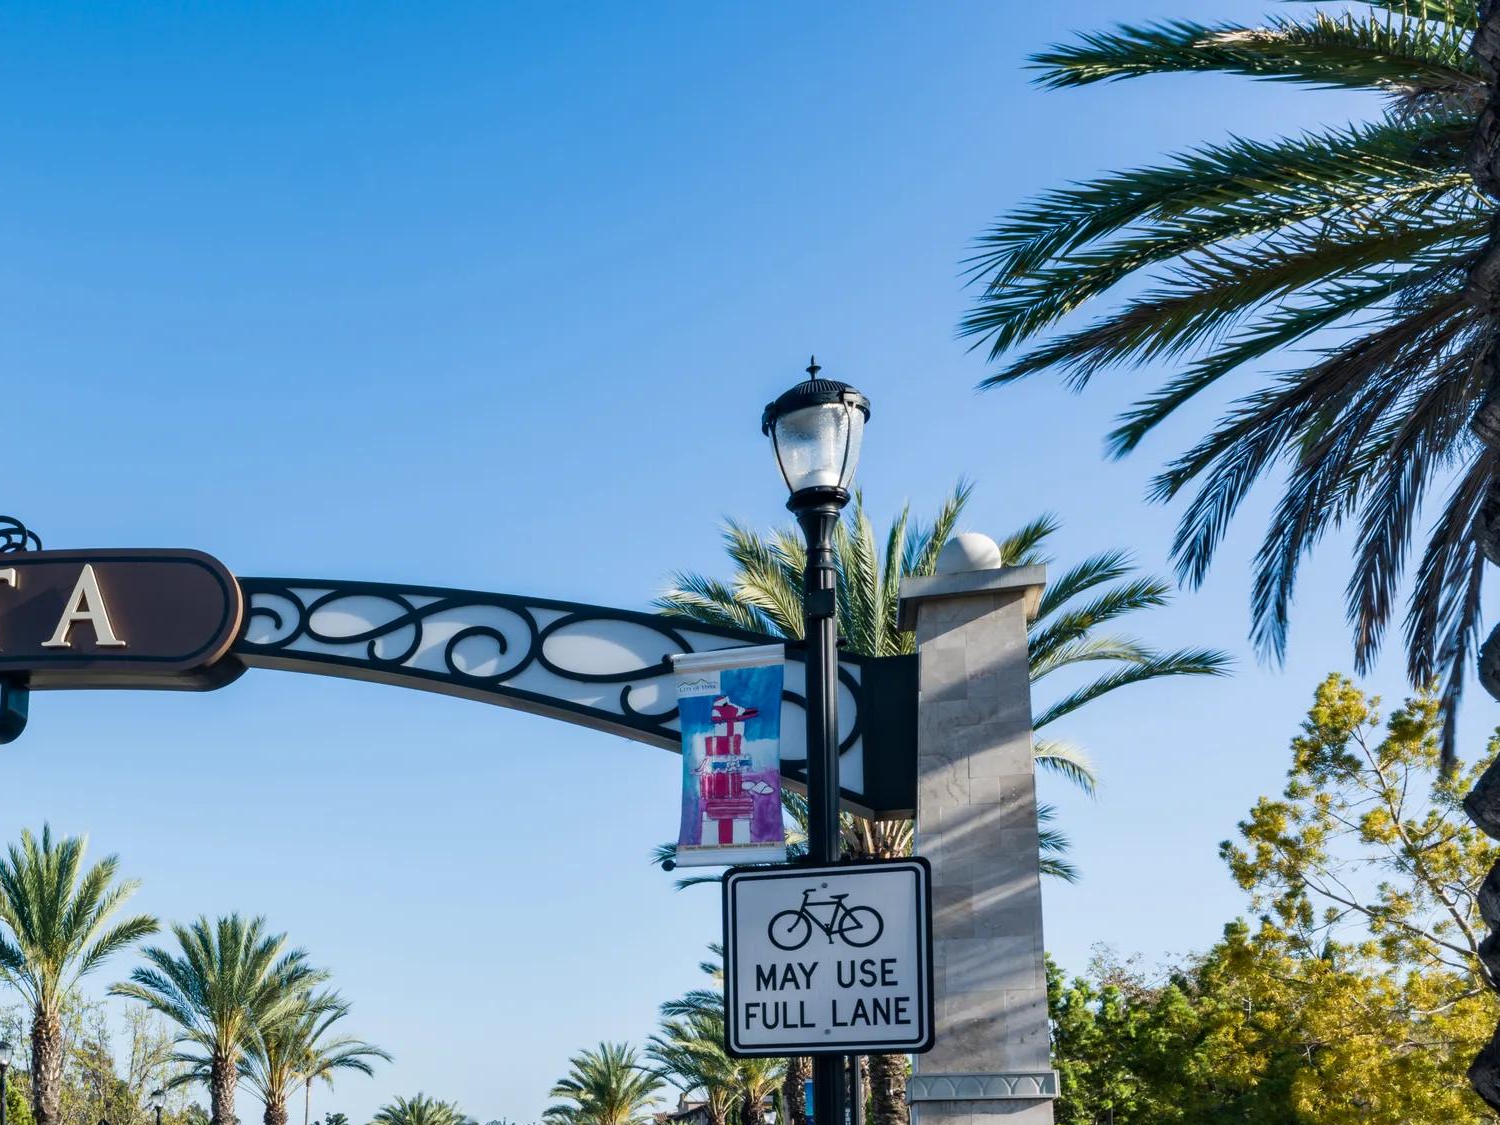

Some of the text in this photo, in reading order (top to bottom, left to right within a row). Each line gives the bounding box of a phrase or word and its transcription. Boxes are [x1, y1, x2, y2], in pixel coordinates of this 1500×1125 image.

[756, 958, 898, 991] MAY USE
[745, 996, 911, 1030] FULL LANE
